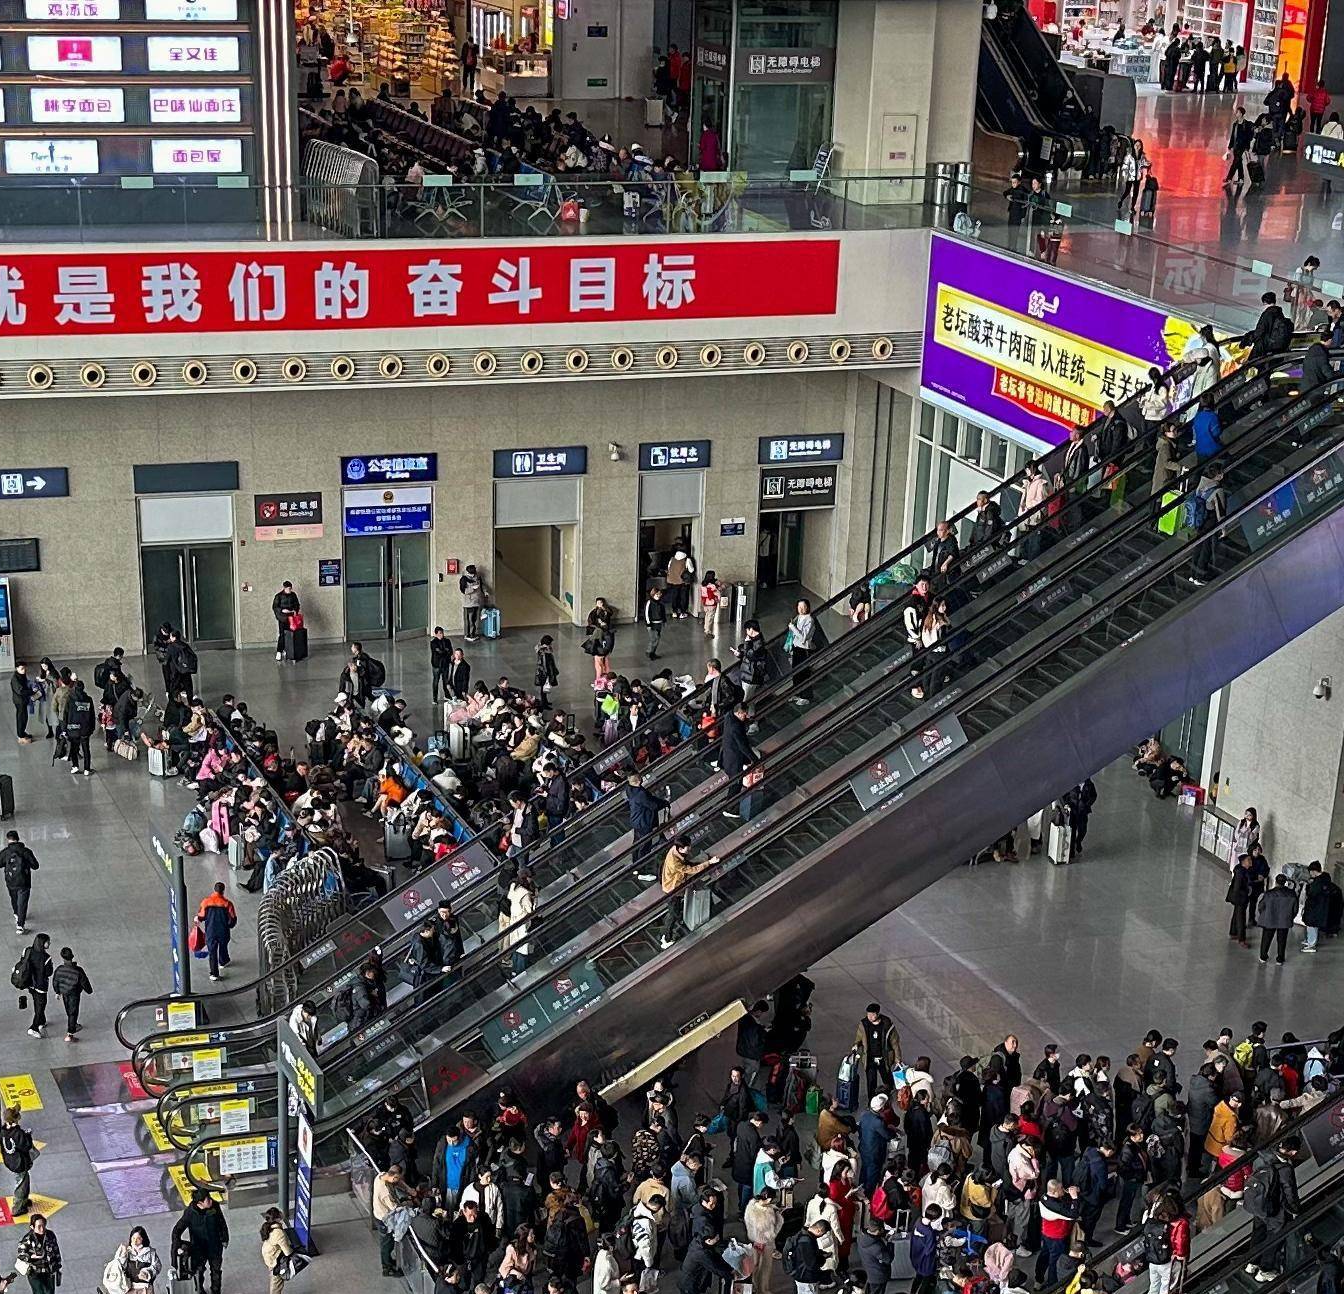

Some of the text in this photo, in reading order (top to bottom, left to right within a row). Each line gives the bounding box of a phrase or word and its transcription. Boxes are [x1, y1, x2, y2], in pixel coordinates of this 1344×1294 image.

[766, 55, 821, 69] 无障碍电梯
[172, 150, 222, 163] 面包屋
[1028, 290, 1059, 318] 统一
[942, 303, 1036, 367] 老坛酸菜牛肉面
[789, 440, 831, 451] 无障碍电梯
[536, 453, 567, 466] 卫生间
[787, 476, 833, 489] 无障碍电梯
[552, 981, 591, 1011] 禁止翻越
